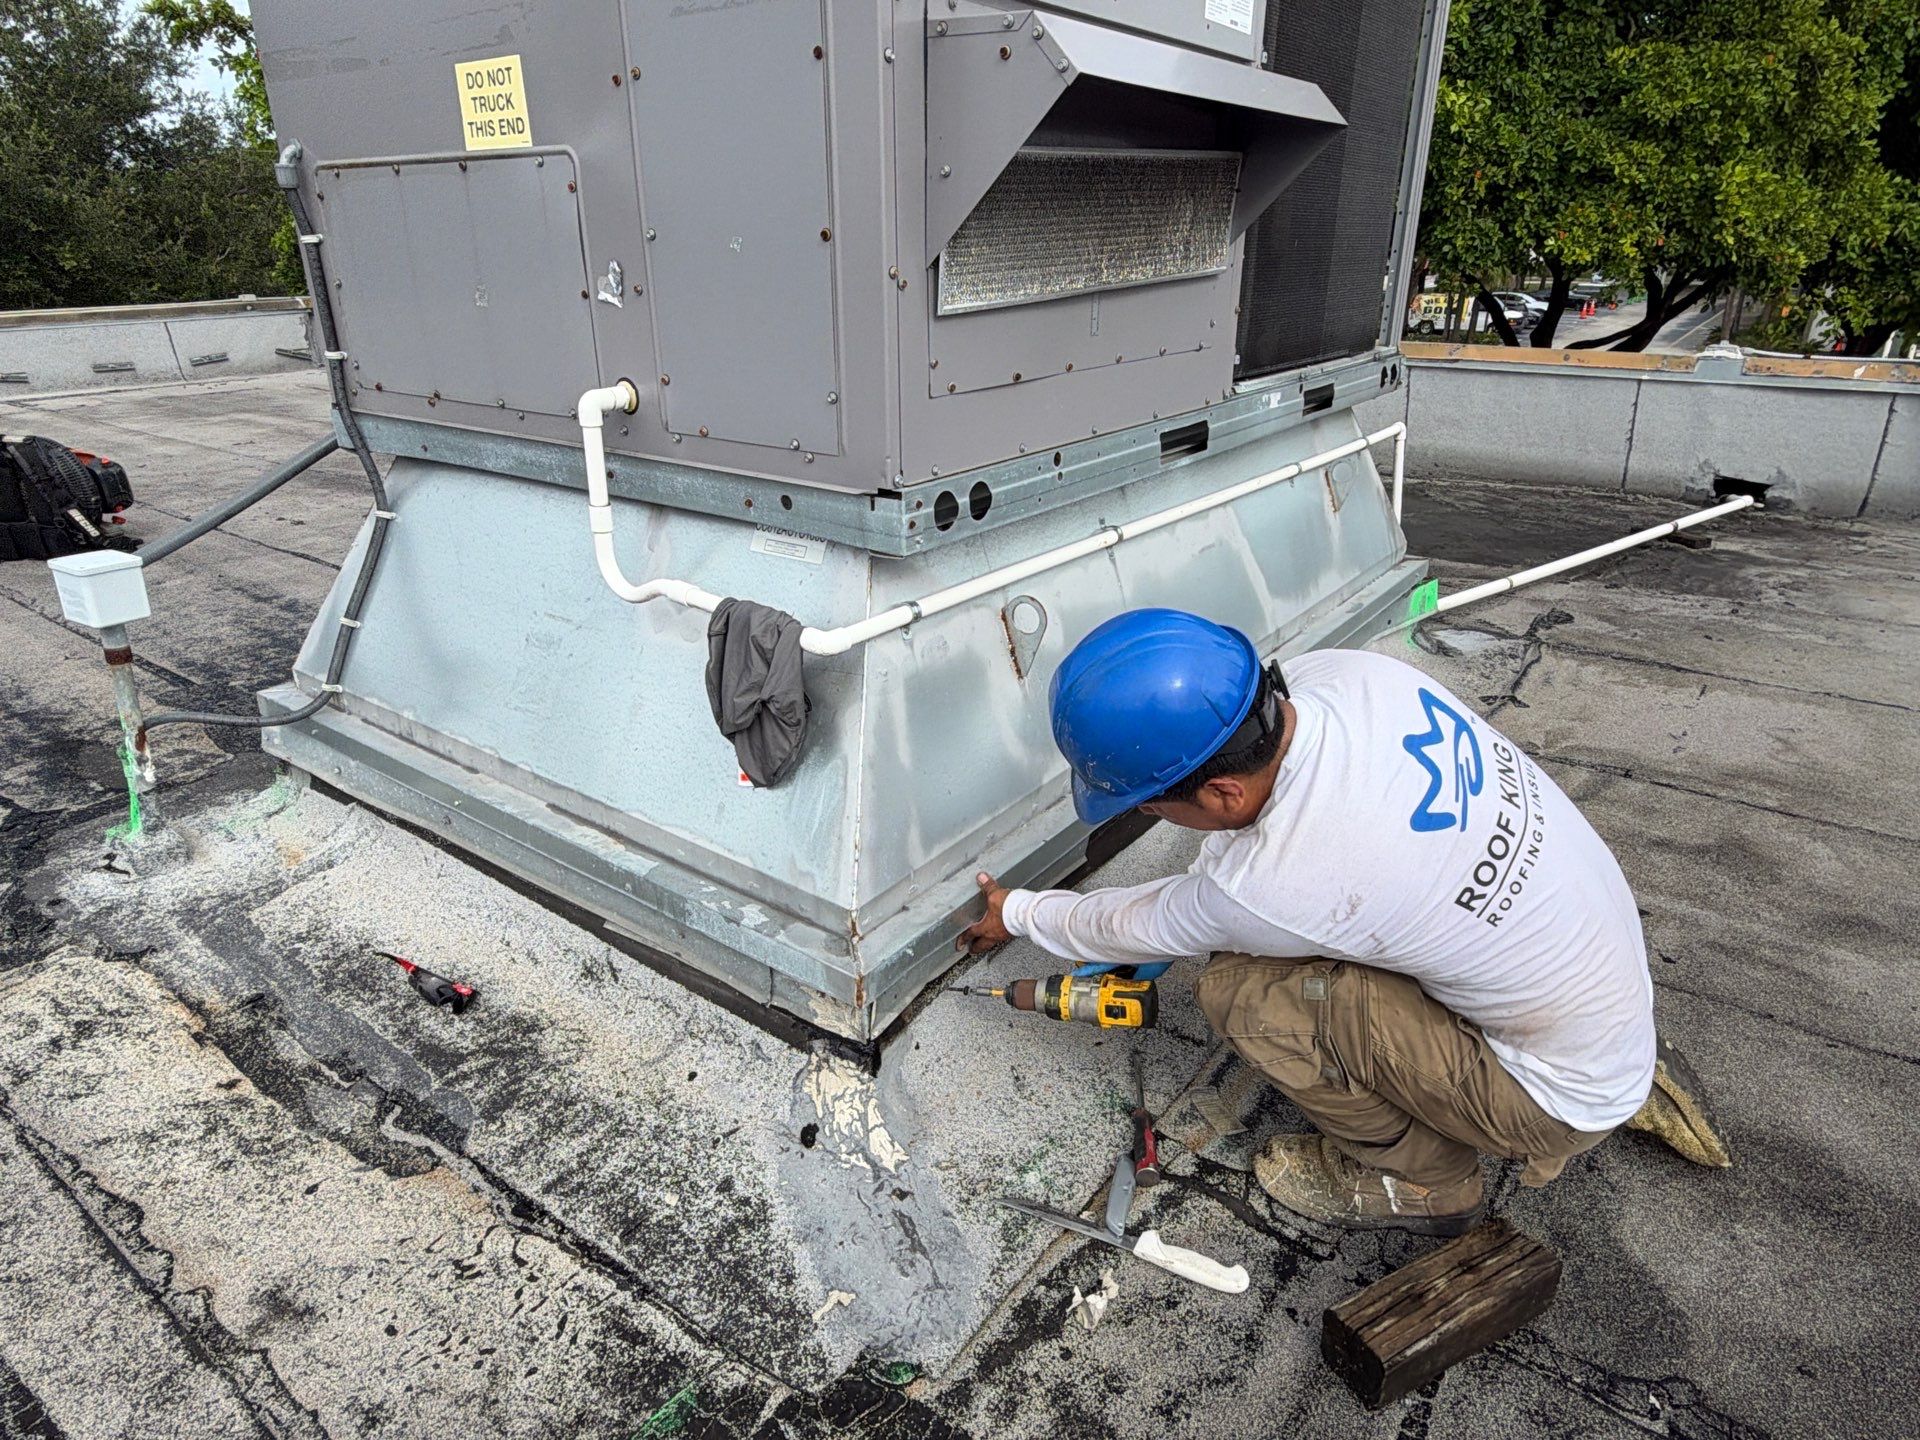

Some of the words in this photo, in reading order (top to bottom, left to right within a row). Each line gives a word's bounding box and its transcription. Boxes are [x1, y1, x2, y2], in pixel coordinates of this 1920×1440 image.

[466, 70, 484, 90] DO
[487, 66, 513, 87] NOT
[471, 92, 516, 114] TRUCK
[467, 119, 496, 138] THIS
[498, 116, 526, 136] END
[1454, 811, 1517, 913] ROOF
[1493, 742, 1521, 810] KING
[1486, 829, 1544, 928] ROOFING
[1532, 813, 1545, 826] &
